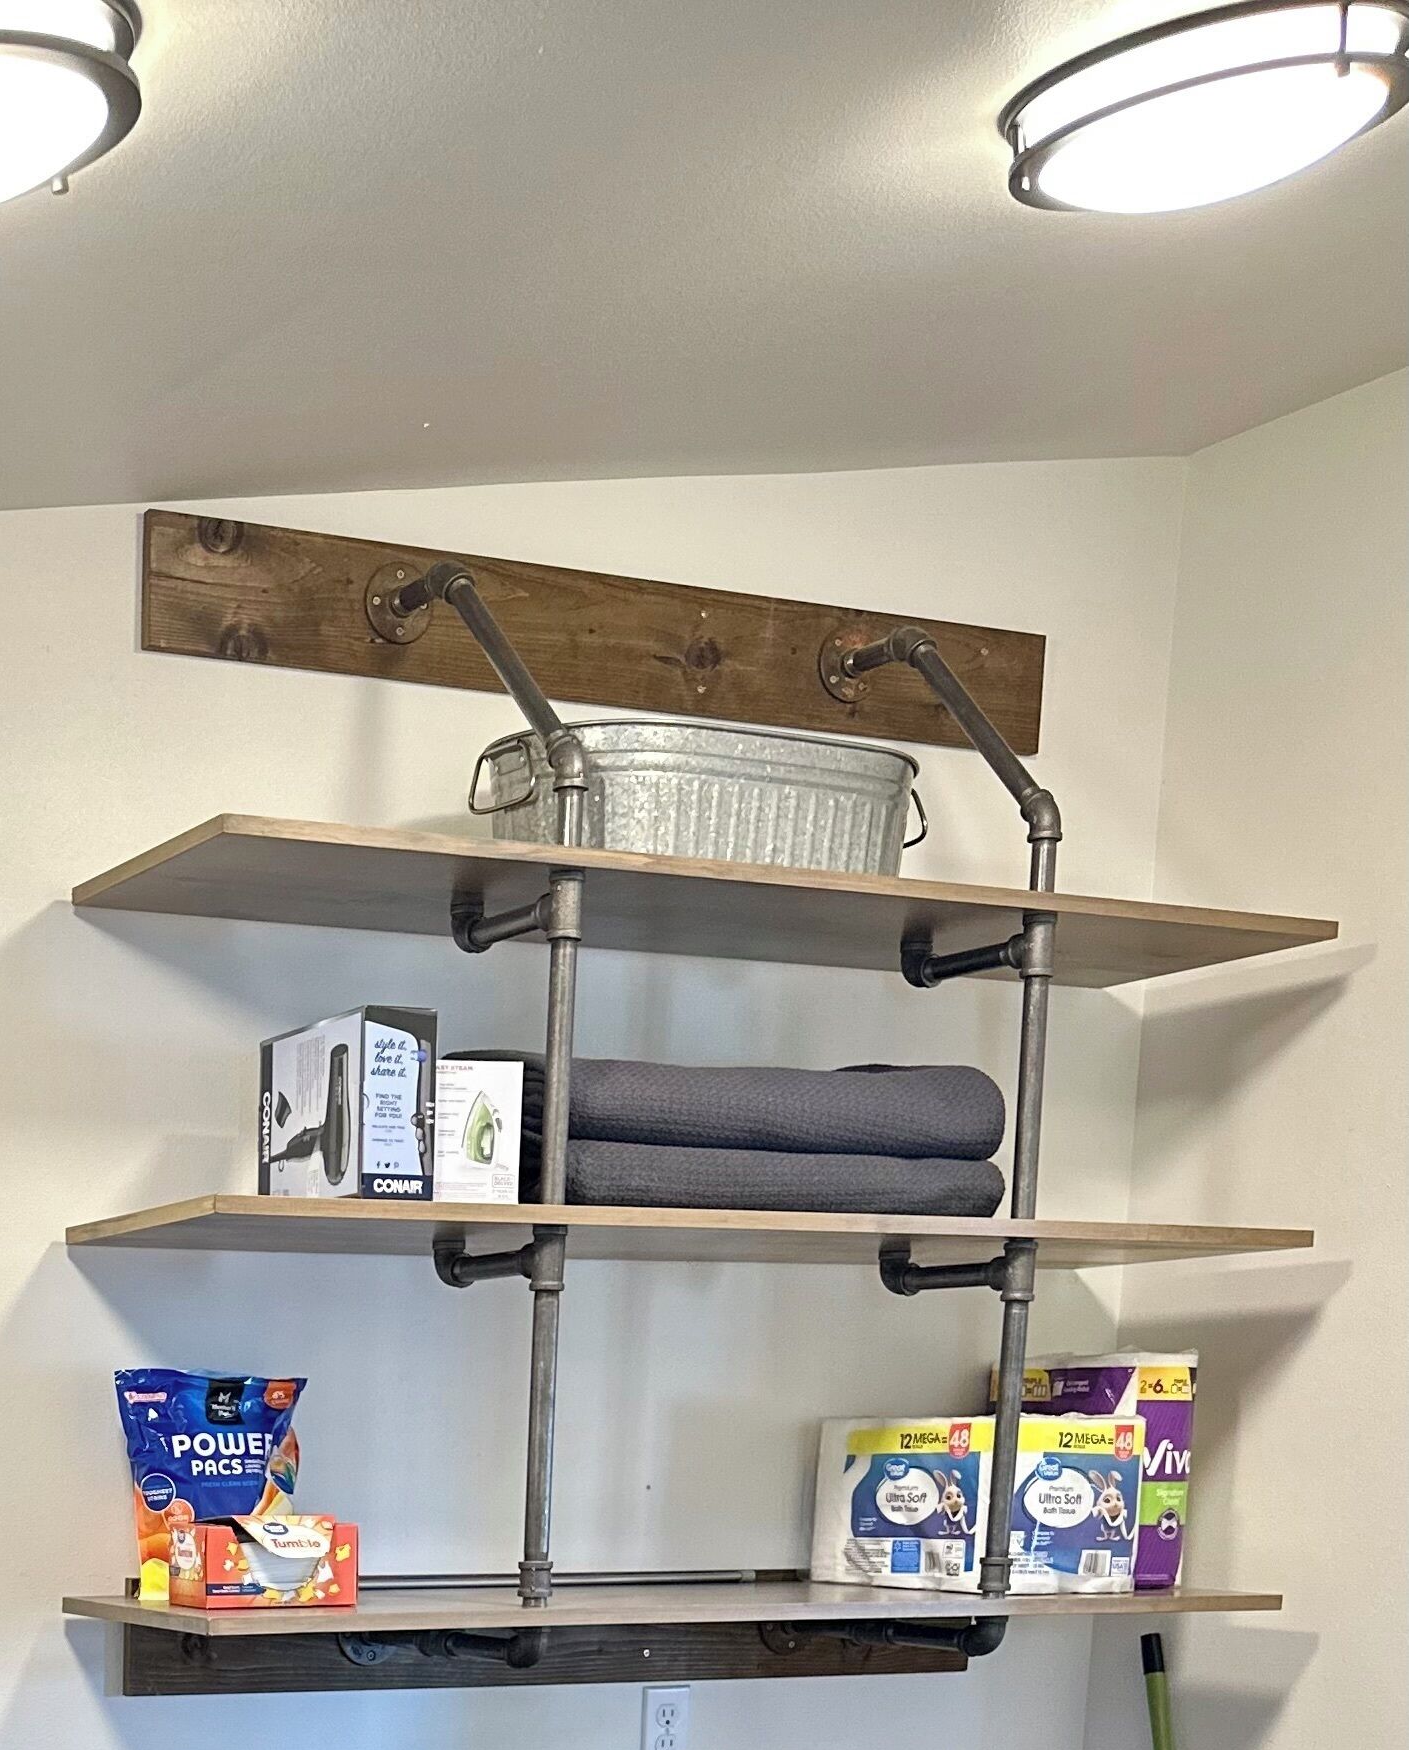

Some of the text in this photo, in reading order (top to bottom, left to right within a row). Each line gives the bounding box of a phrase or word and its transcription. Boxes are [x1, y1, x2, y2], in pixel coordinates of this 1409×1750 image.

[374, 1038, 396, 1054] style
[375, 1052, 392, 1063] love
[370, 1065, 396, 1076] share
[262, 1091, 271, 1164] CONAIR
[373, 1178, 423, 1195] CONAIR
[900, 1433, 912, 1449] 12
[913, 1432, 941, 1444] MEGA
[950, 1428, 970, 1448] 48
[1059, 1432, 1073, 1448] 12
[1074, 1432, 1107, 1445] MEGA
[1115, 1431, 1133, 1450] 48
[191, 1459, 243, 1476] PACS
[886, 1492, 927, 1503] Ultra Soft
[1039, 1493, 1082, 1505] Ultra Soft
[270, 1538, 321, 1548] Tumble
